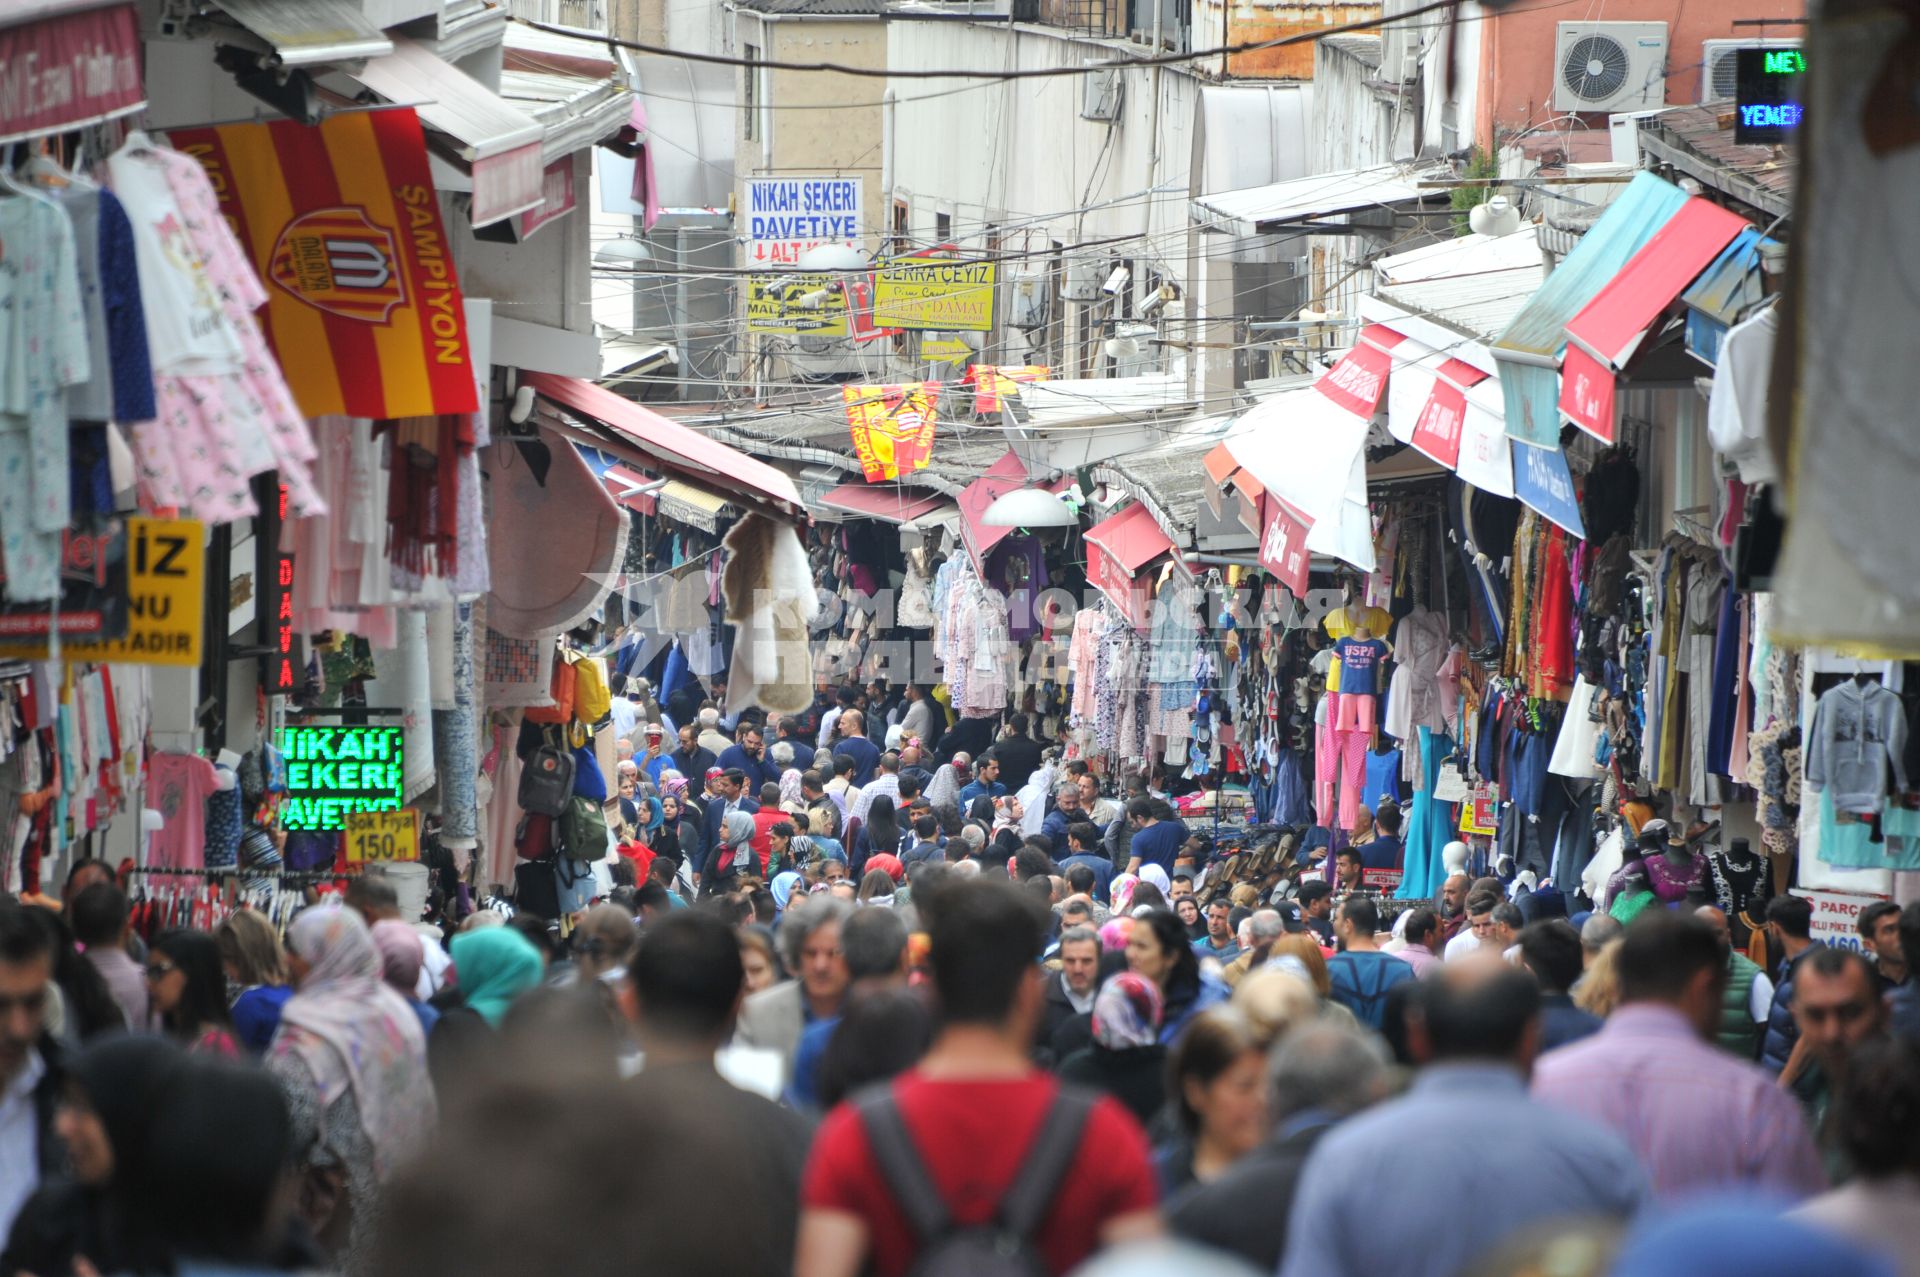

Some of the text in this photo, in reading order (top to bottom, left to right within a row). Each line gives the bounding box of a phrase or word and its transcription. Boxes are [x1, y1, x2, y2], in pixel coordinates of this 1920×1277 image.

[752, 181, 856, 215] NİKAH ŞEKERİ
[751, 215, 857, 240] DAVETİYE
[770, 242, 801, 263] ALT
[397, 185, 463, 365] ŞAMPİYON
[932, 301, 986, 315] DAMAT
[135, 524, 188, 576] İZ
[1344, 645, 1375, 658] USPA
[288, 762, 398, 790] EKERİ
[355, 833, 395, 859] 150
[1829, 919, 1847, 933] PİKE
